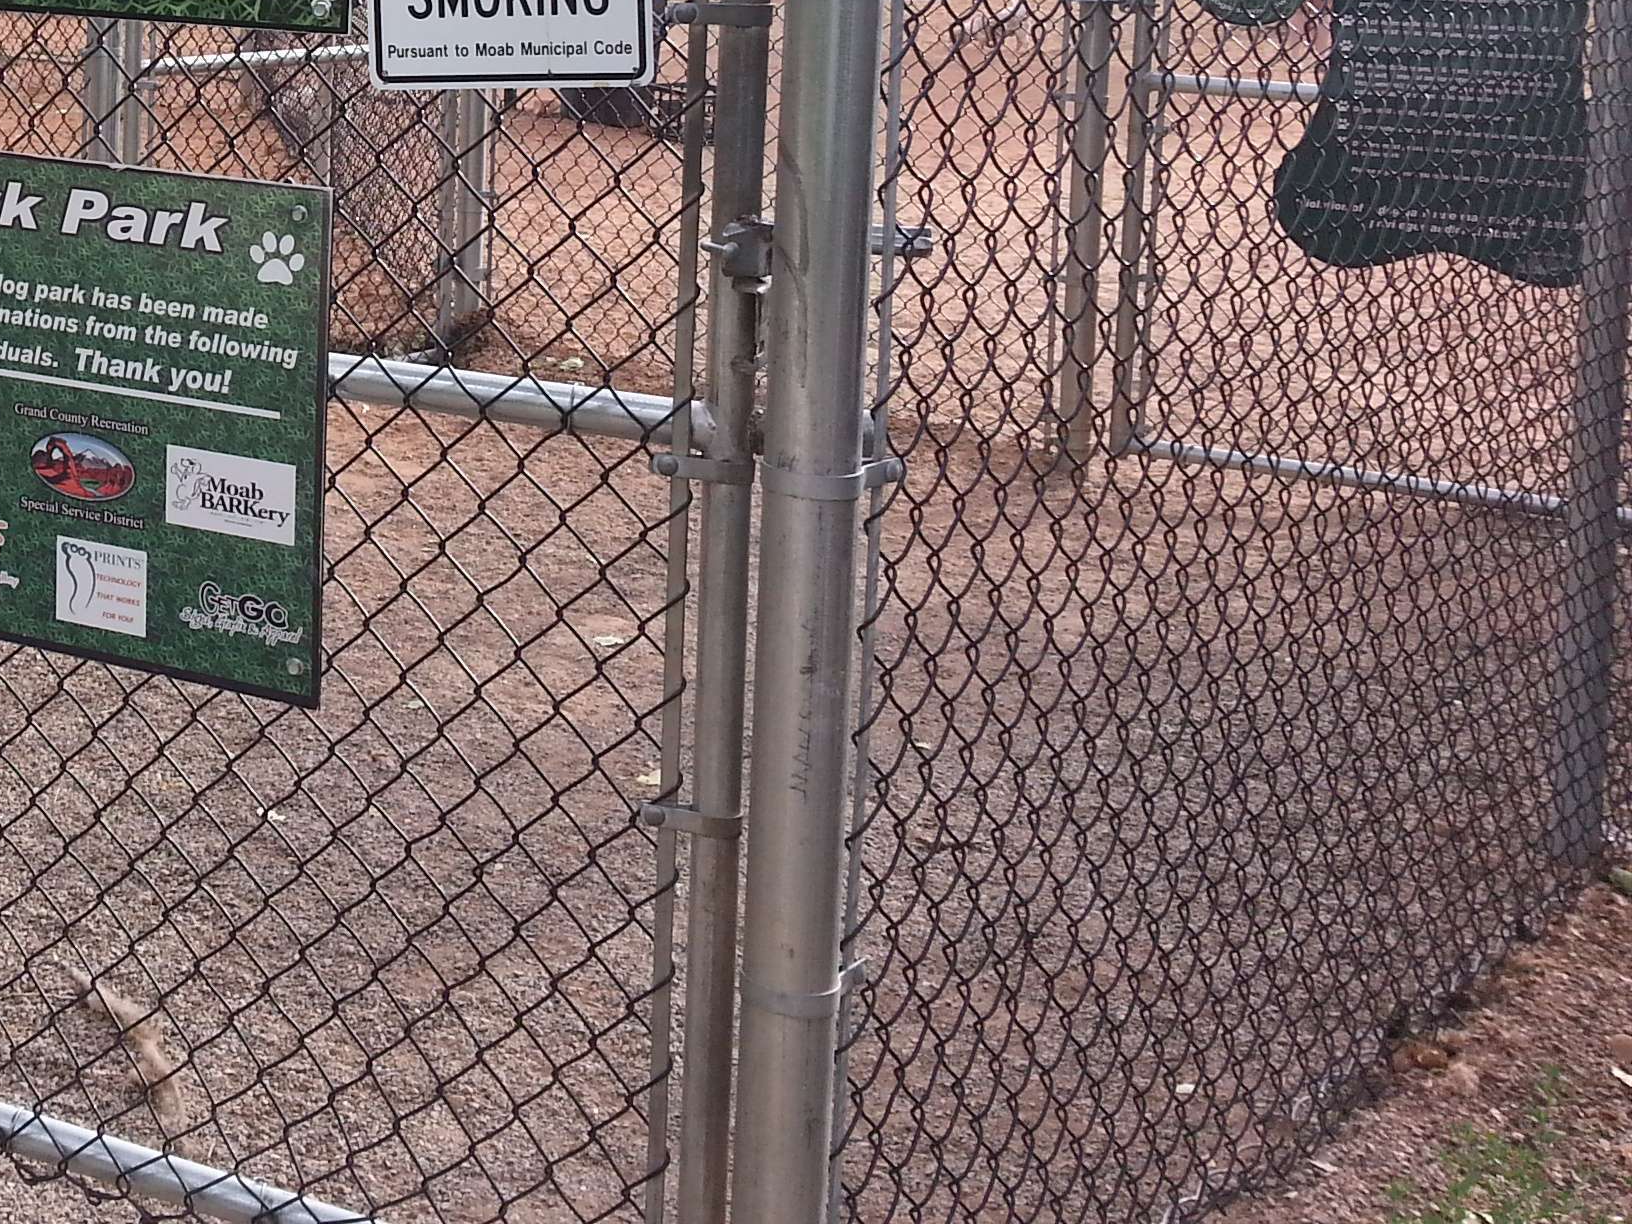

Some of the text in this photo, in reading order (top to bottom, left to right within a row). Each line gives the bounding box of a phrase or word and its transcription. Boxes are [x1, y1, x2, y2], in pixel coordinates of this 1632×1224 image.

[387, 40, 633, 59] Pursuant to Moab Municipal Code
[60, 188, 230, 253] Park
[34, 283, 85, 304] park
[91, 287, 132, 309] has
[138, 293, 196, 319] been
[202, 307, 268, 329] made
[85, 315, 137, 341] from
[144, 325, 183, 348] the
[189, 329, 299, 370] following
[74, 347, 162, 383] Thank
[168, 368, 233, 394] you!
[14, 403, 149, 435] Grand County Recreation
[207, 476, 264, 501] Moab
[20, 496, 144, 529] Special Service District
[200, 491, 291, 528] BARKery
[96, 573, 142, 588] TECHNOLOGY
[97, 591, 140, 607] THAT WORKS
[102, 611, 116, 620] FOR
